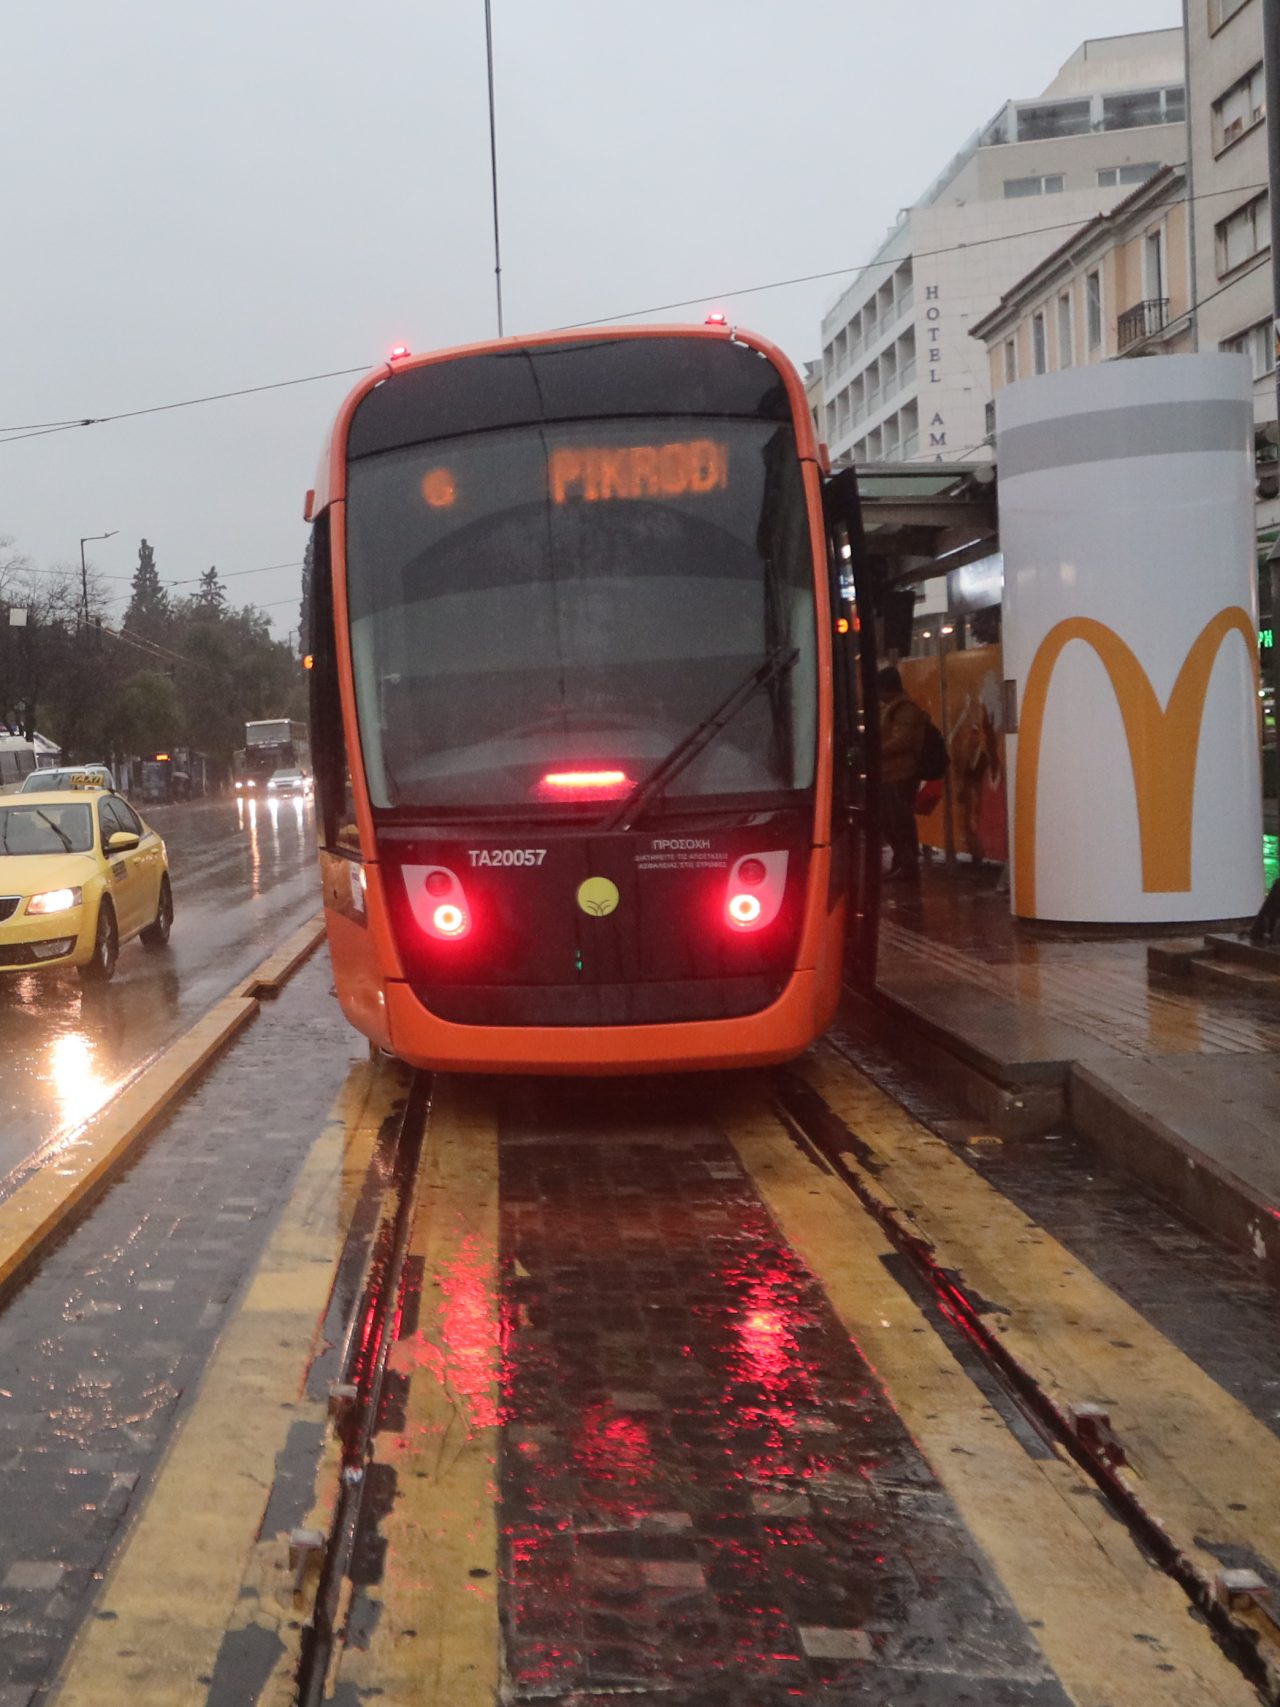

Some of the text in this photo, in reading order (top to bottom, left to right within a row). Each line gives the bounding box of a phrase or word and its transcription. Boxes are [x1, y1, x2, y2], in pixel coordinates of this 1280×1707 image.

[925, 286, 942, 384] HOTEL
[652, 839, 711, 850] ΠΡΟΣΟΧΗ
[468, 849, 548, 867] TA20057
